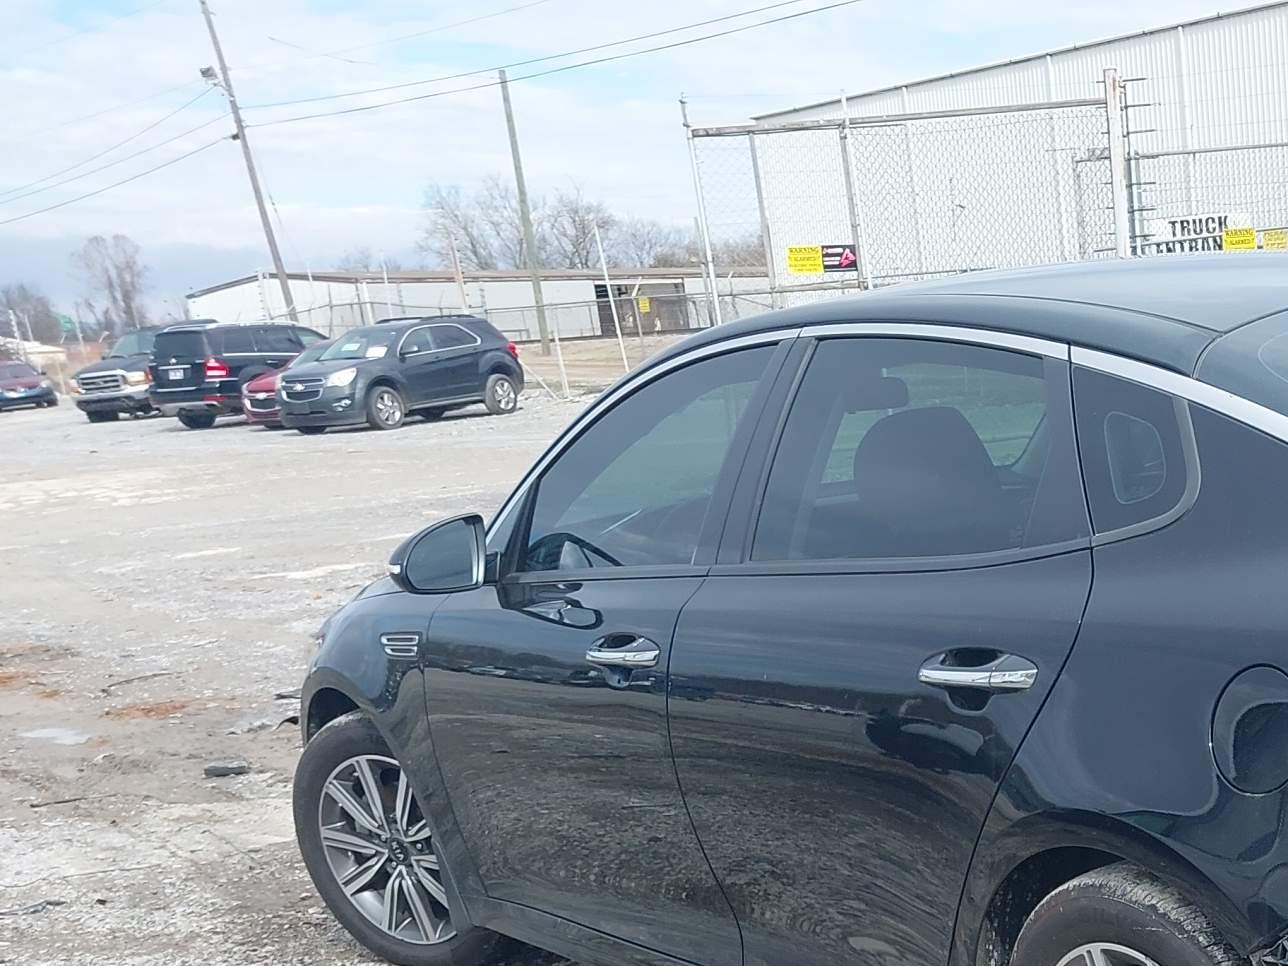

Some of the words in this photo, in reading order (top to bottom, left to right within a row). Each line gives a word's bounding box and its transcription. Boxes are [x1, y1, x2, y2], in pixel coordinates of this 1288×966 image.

[1168, 215, 1229, 238] TRUCK
[1225, 228, 1254, 237] WARNING
[1155, 235, 1224, 254] ENTRAN
